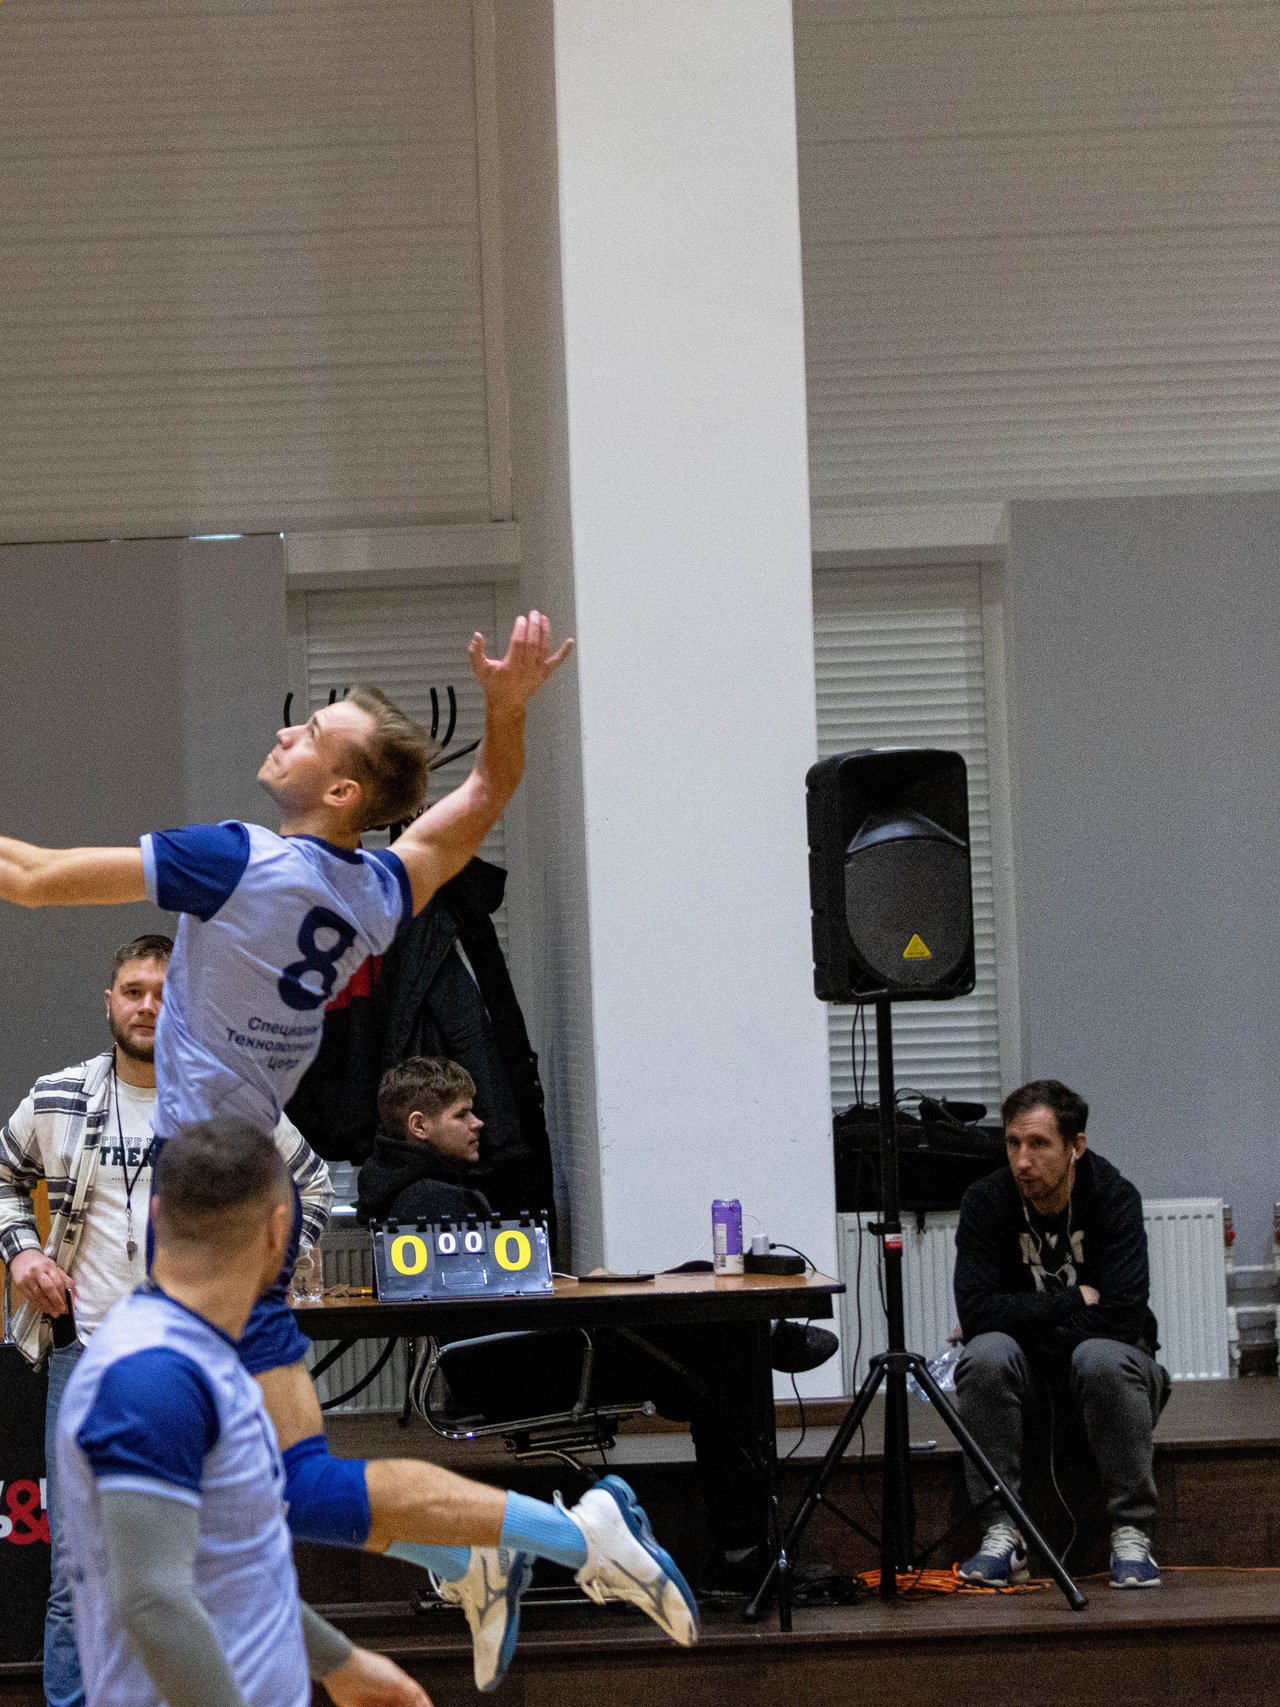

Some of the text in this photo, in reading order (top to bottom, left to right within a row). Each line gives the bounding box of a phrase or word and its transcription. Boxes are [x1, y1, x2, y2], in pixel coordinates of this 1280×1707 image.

[278, 906, 357, 1011] 8
[390, 1230, 532, 1276] 0 0 0 0
